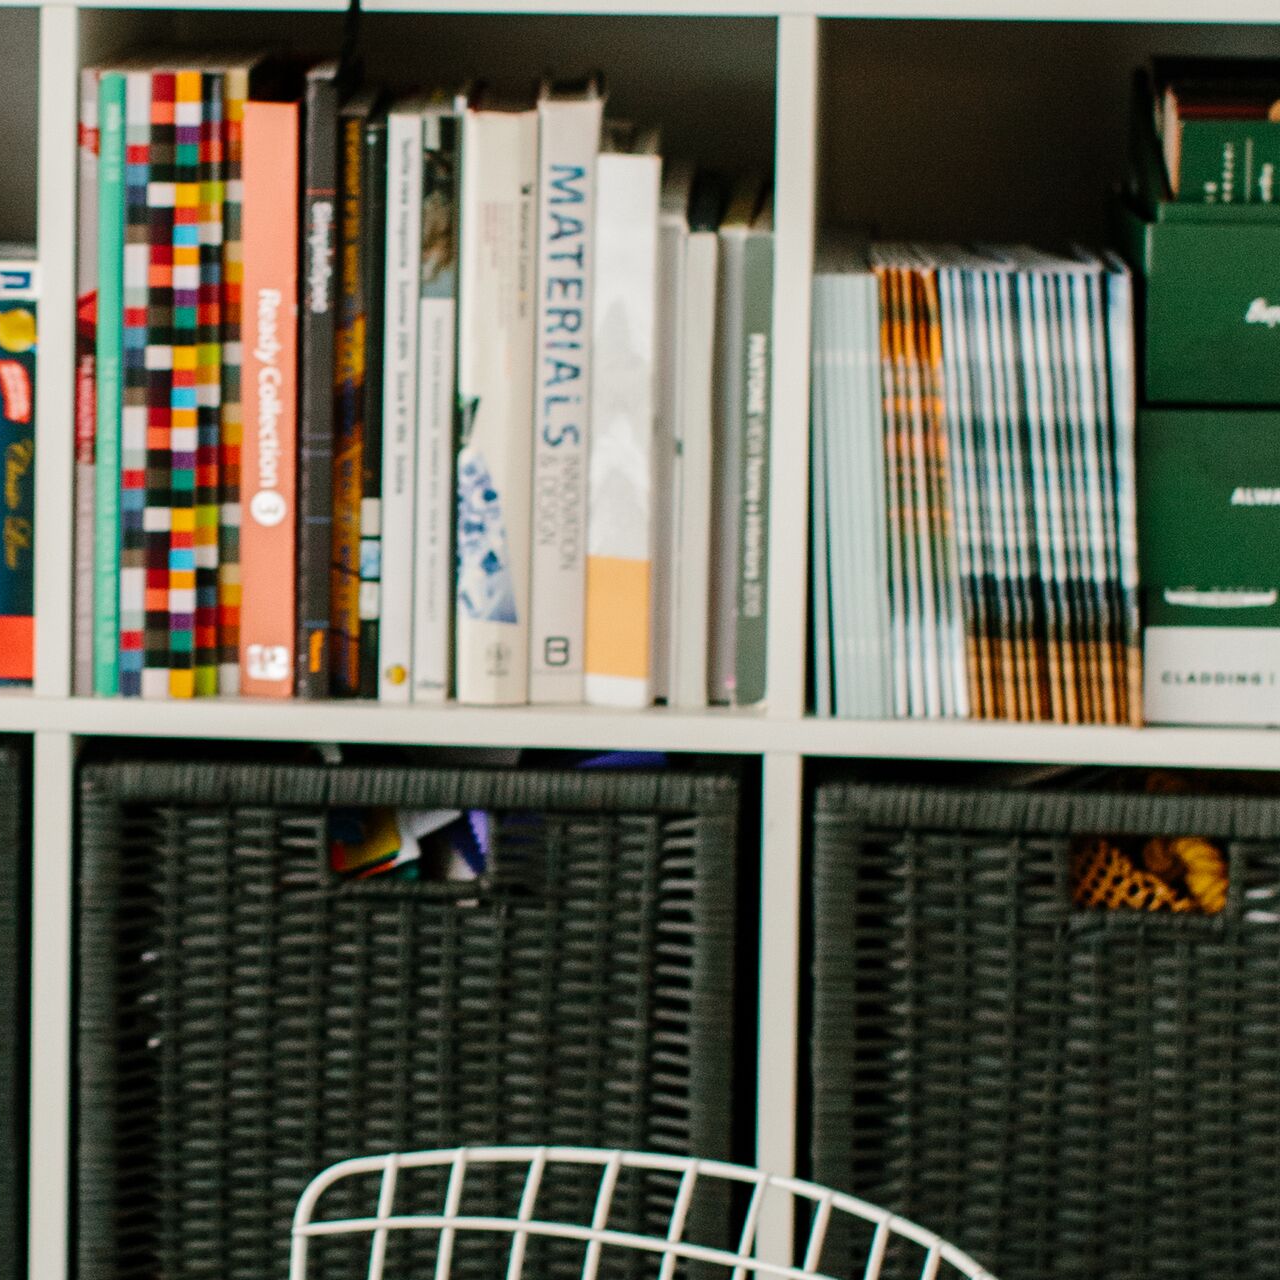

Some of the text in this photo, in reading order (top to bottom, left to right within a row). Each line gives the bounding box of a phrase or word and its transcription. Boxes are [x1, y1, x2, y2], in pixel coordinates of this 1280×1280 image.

[253, 288, 283, 362] Ready
[541, 162, 588, 450] MATERIALS
[255, 366, 284, 488] Collection
[1160, 671, 1263, 686] CLADDING
